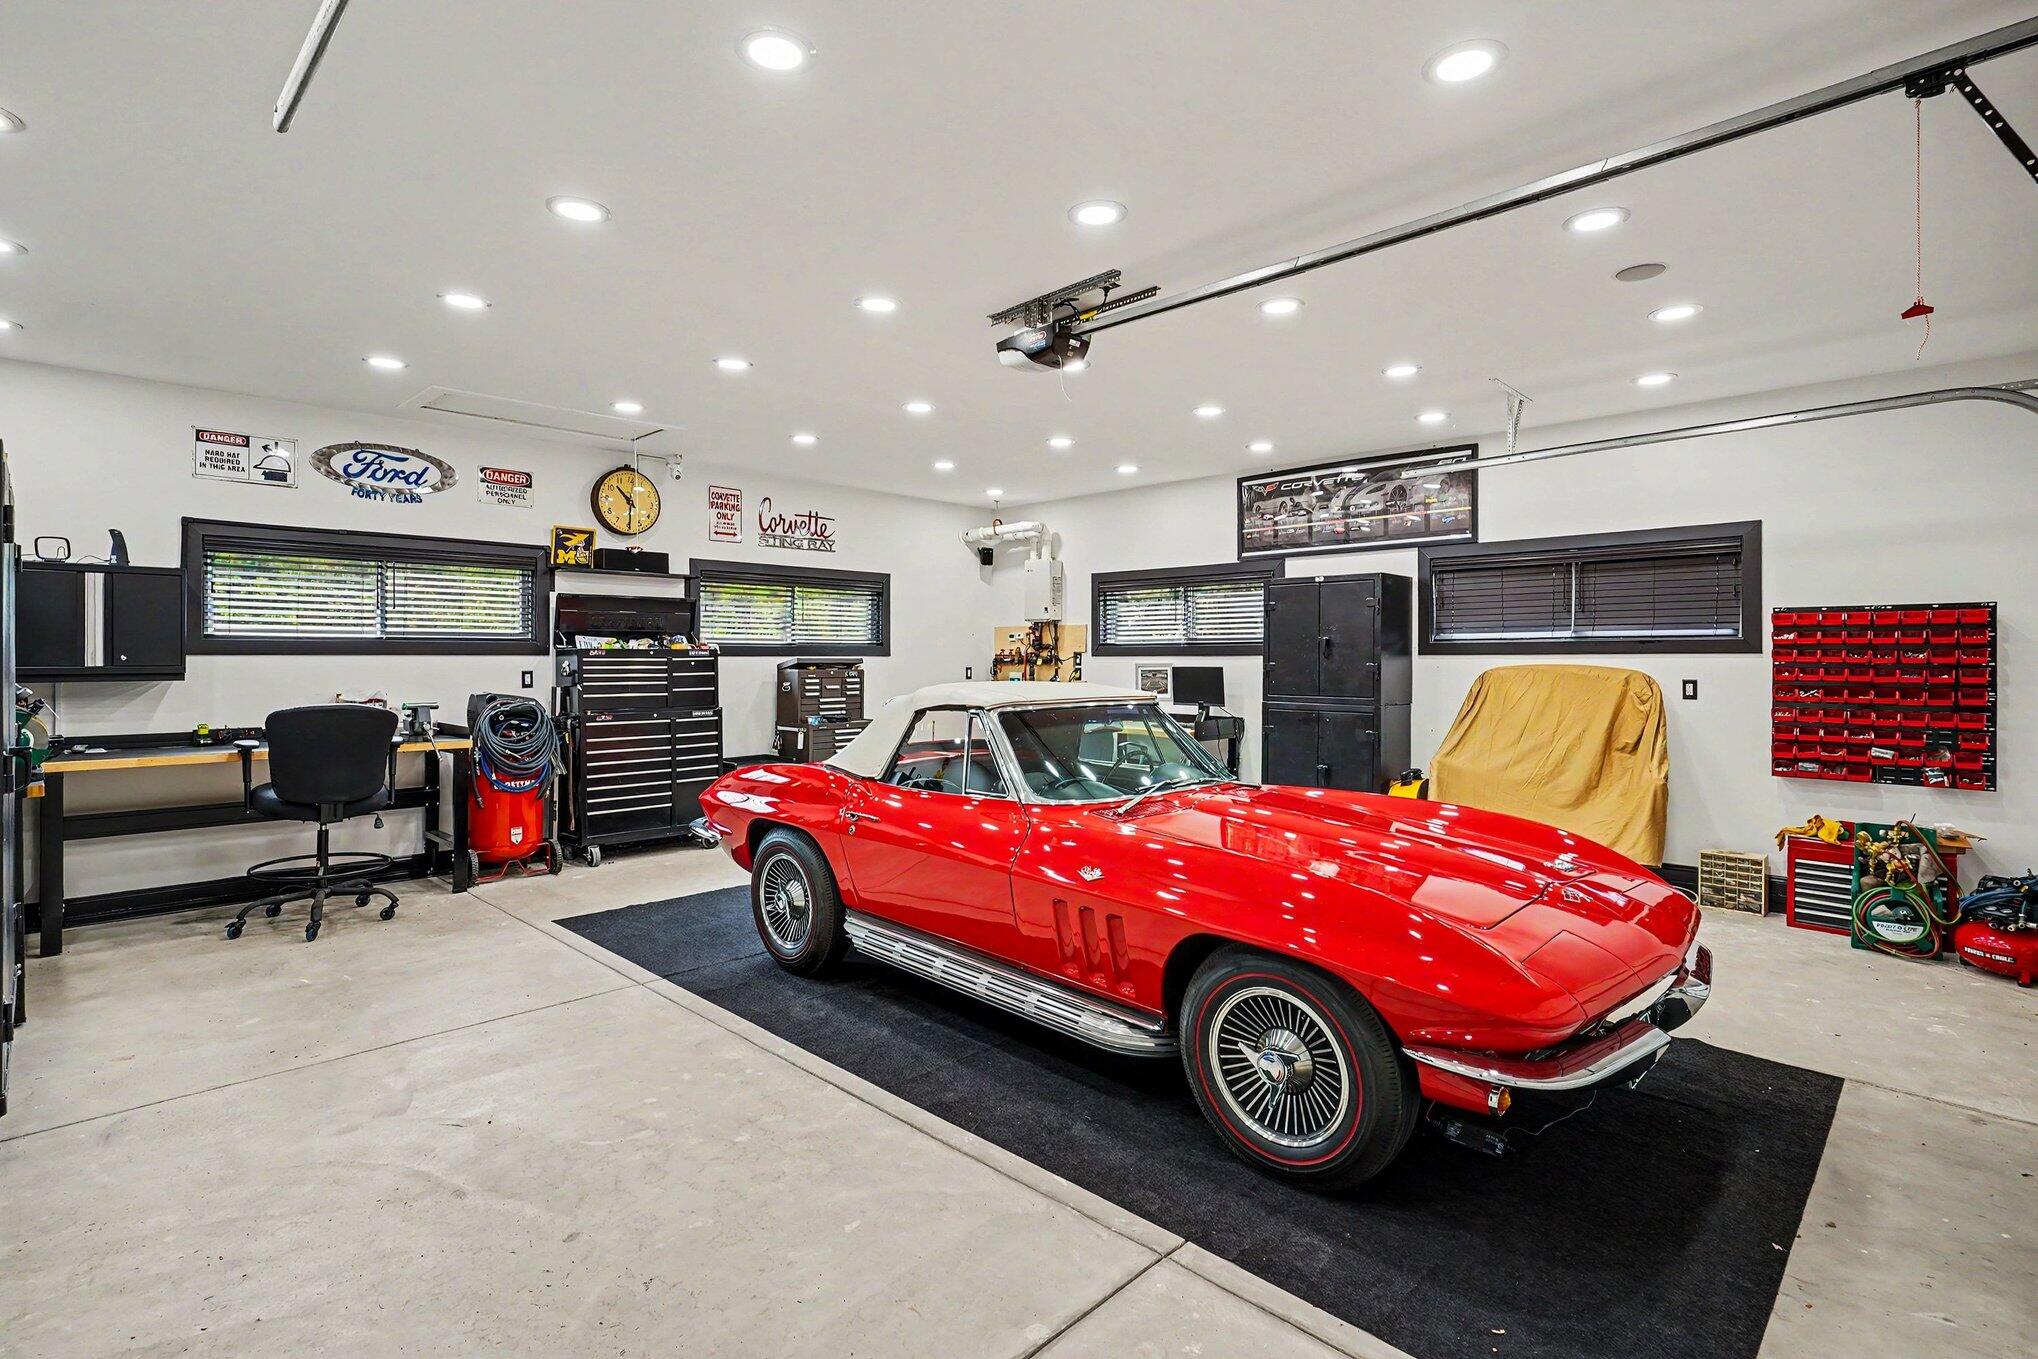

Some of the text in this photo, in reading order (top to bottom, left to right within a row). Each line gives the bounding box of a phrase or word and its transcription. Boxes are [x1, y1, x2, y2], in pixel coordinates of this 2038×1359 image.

[203, 433, 244, 445] DANGER
[205, 449, 224, 457] HARD
[204, 455, 241, 466] REQUIRED
[199, 461, 246, 473] IN THIS AREA
[342, 448, 430, 488] Ford
[485, 470, 527, 484] DANGER
[350, 487, 423, 504] FORTY YEARS
[497, 497, 516, 505] ONLY
[711, 491, 740, 503] CORVETTE
[710, 500, 741, 512] PARKING
[716, 511, 735, 521] ONLY
[758, 496, 836, 539] Corvette
[758, 535, 836, 552] STING RAY
[556, 549, 577, 565] M
